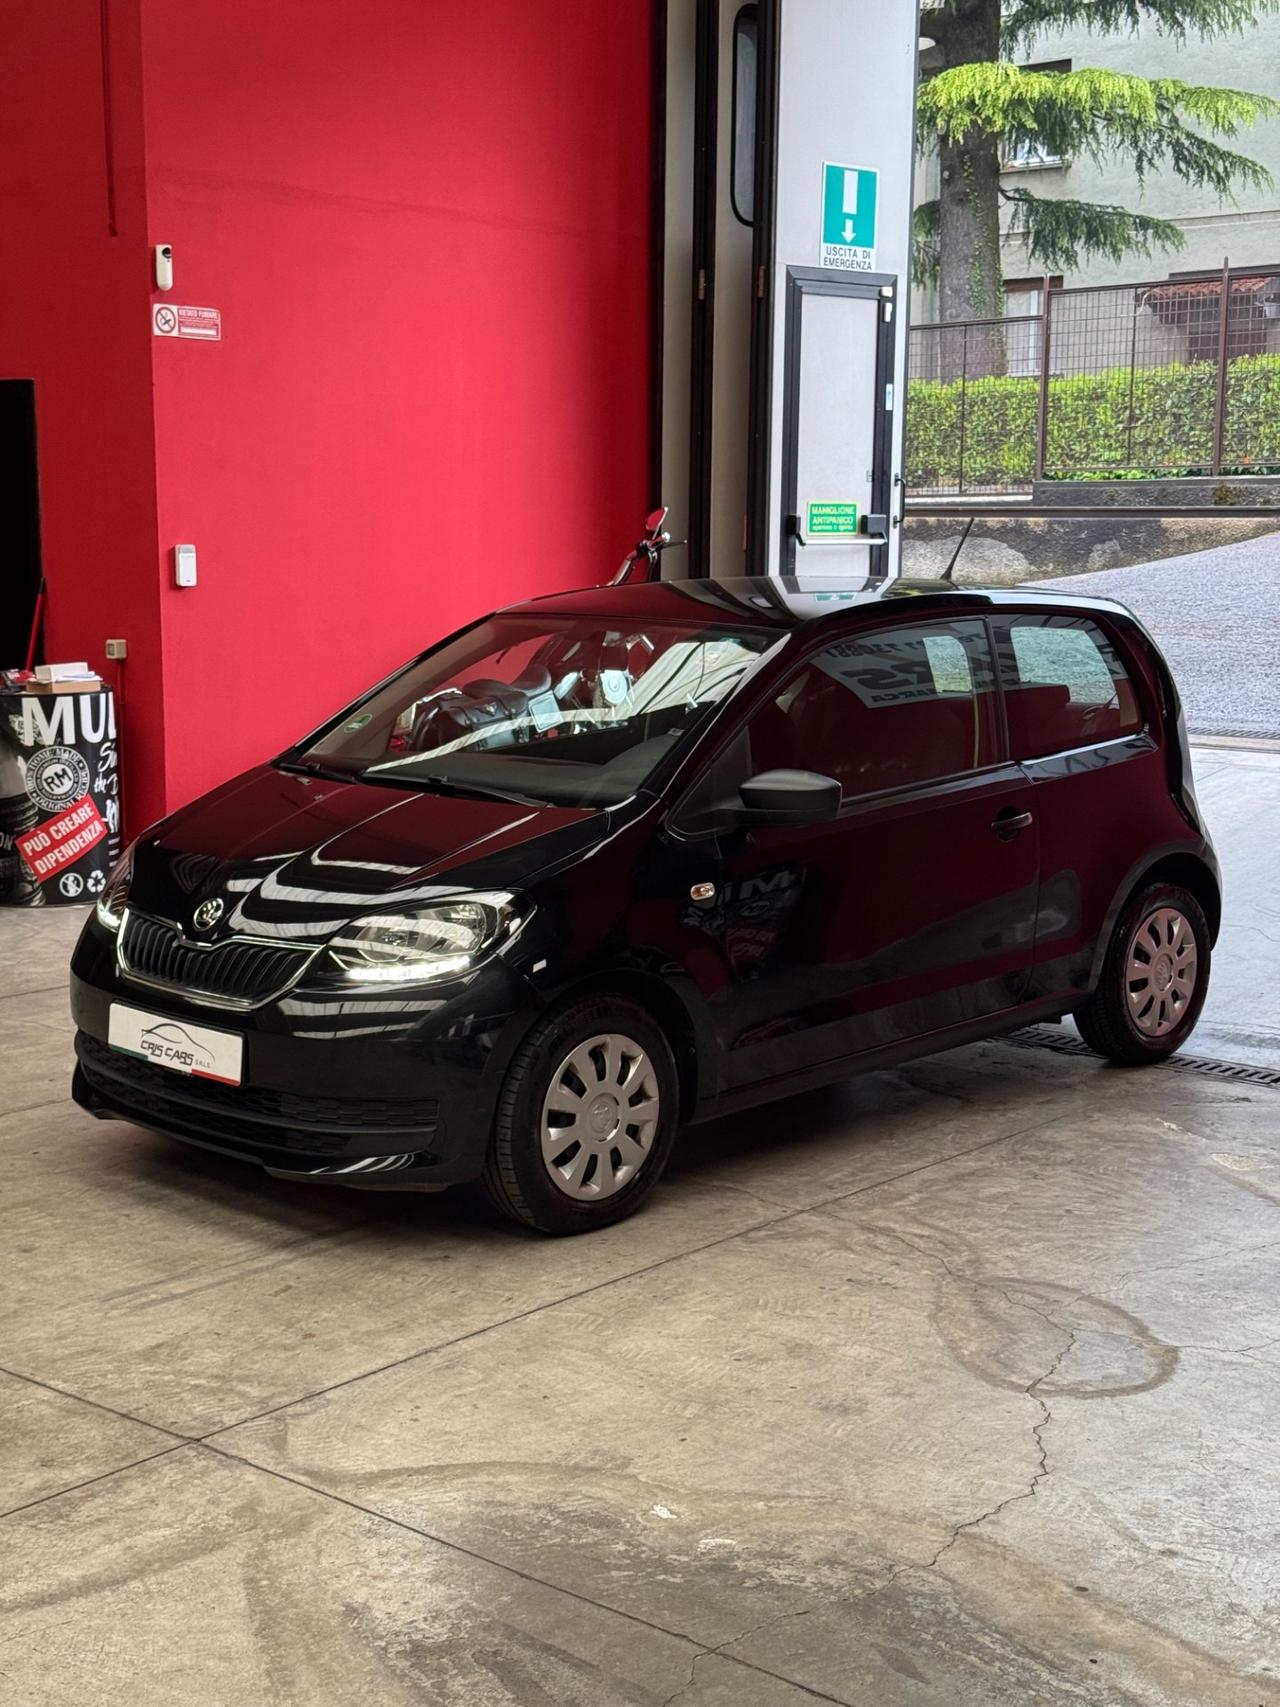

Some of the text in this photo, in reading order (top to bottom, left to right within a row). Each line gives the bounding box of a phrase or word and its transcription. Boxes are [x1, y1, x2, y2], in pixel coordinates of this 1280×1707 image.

[826, 245, 871, 259] USCITA DI
[823, 257, 872, 270] EMERGENZA
[811, 506, 855, 515] MANIGLIONE
[812, 516, 854, 525] ANTIPANICO
[43, 767, 73, 792] RM
[23, 801, 95, 856] PUÒ CREARE
[34, 820, 103, 874] DIPENDENZA
[140, 1040, 164, 1058] CRIS
[164, 1047, 195, 1066] CARS
